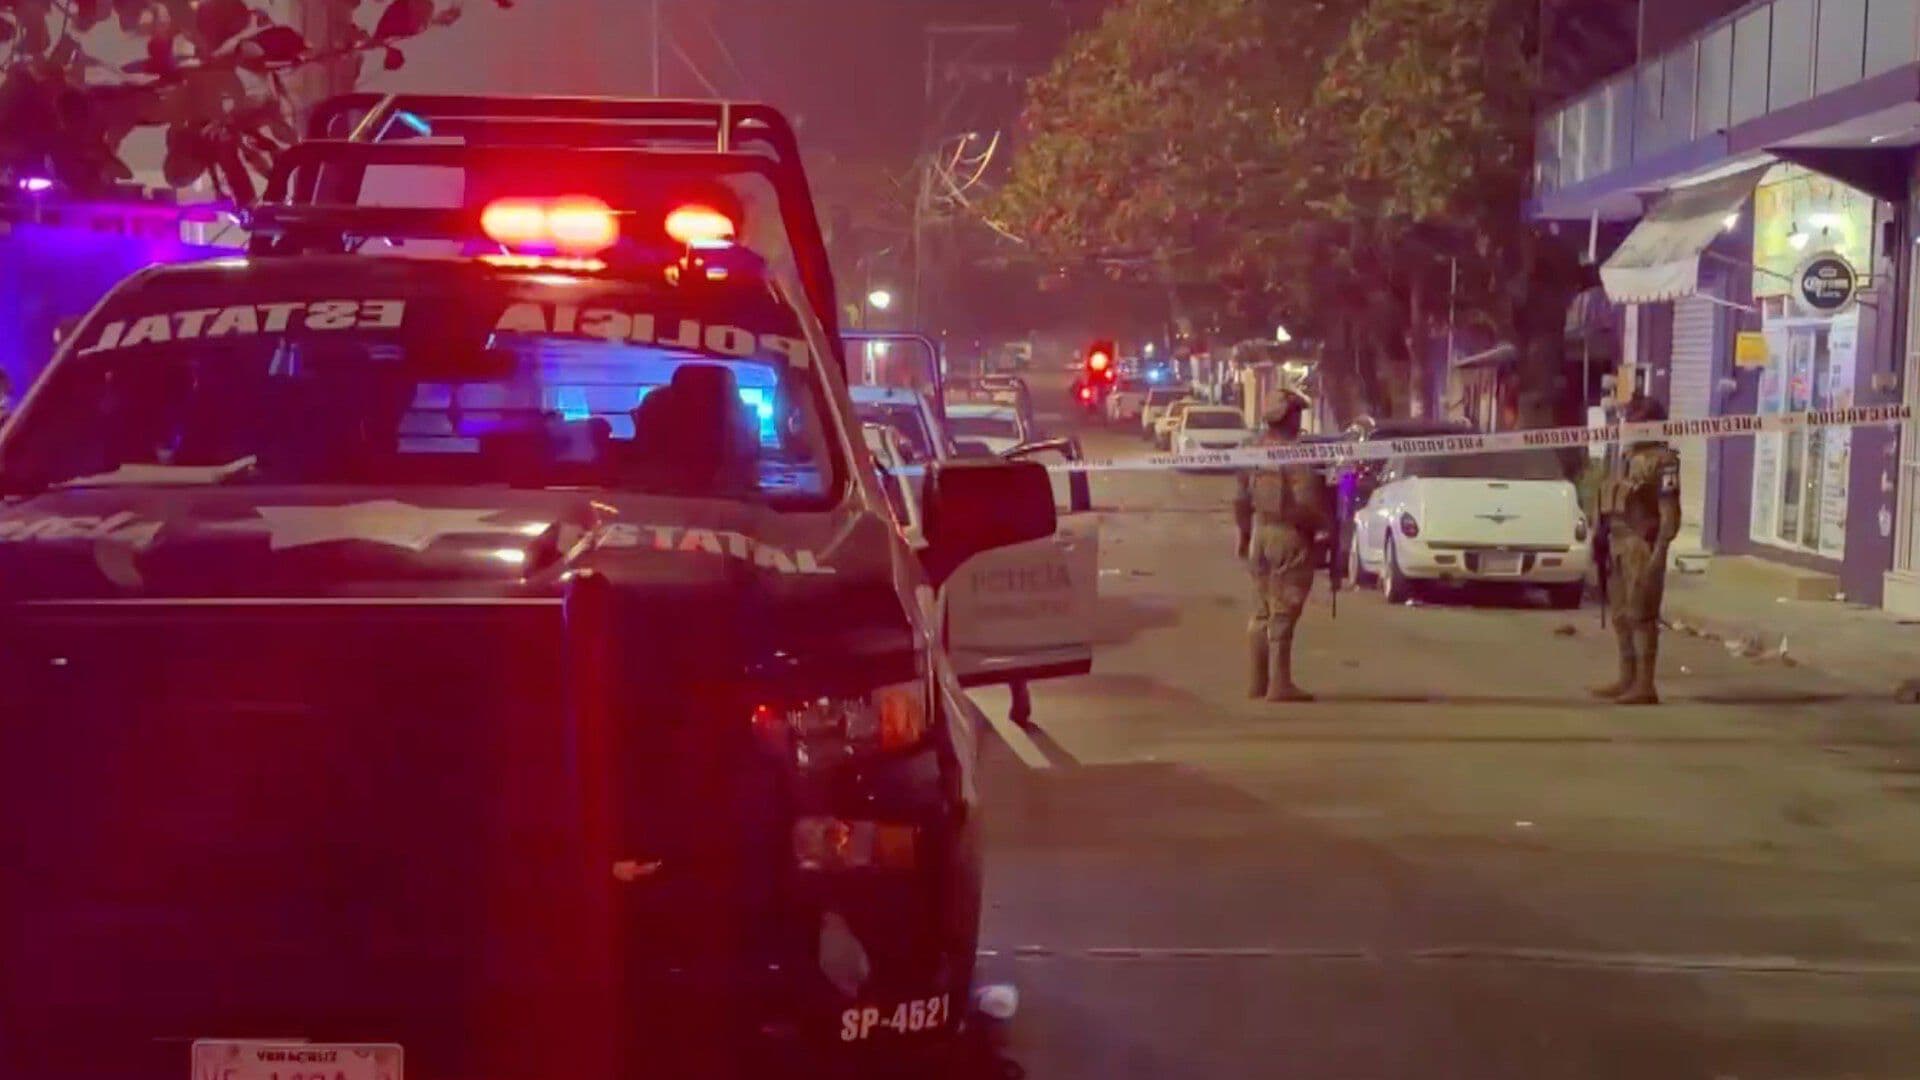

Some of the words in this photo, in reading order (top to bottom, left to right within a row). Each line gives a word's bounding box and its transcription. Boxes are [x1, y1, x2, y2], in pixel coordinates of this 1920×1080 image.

[1806, 405, 1912, 426] PRECAUCION
[1522, 426, 1620, 446] PRECAUCION
[1662, 416, 1763, 436] PRECAUCION
[1391, 436, 1485, 453] PRECAUCION
[840, 993, 950, 1041] SP-4521
